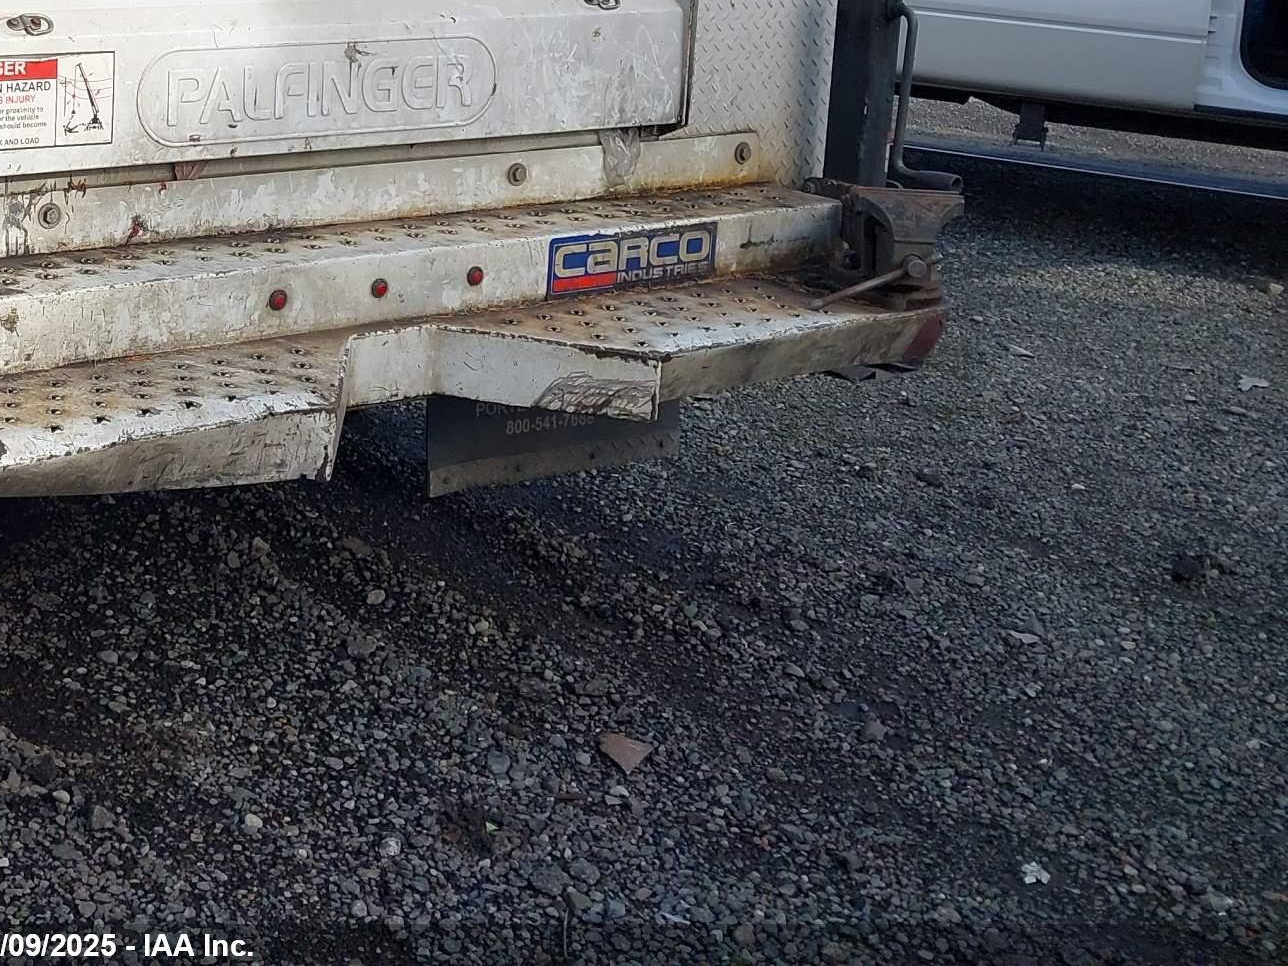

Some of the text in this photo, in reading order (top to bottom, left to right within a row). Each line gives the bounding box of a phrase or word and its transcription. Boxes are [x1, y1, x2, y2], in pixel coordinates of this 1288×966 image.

[6, 81, 51, 93] HAZARD
[165, 55, 473, 127] PALFINGER
[5, 94, 36, 104] INJURY
[617, 261, 709, 283] INDUSTRIES
